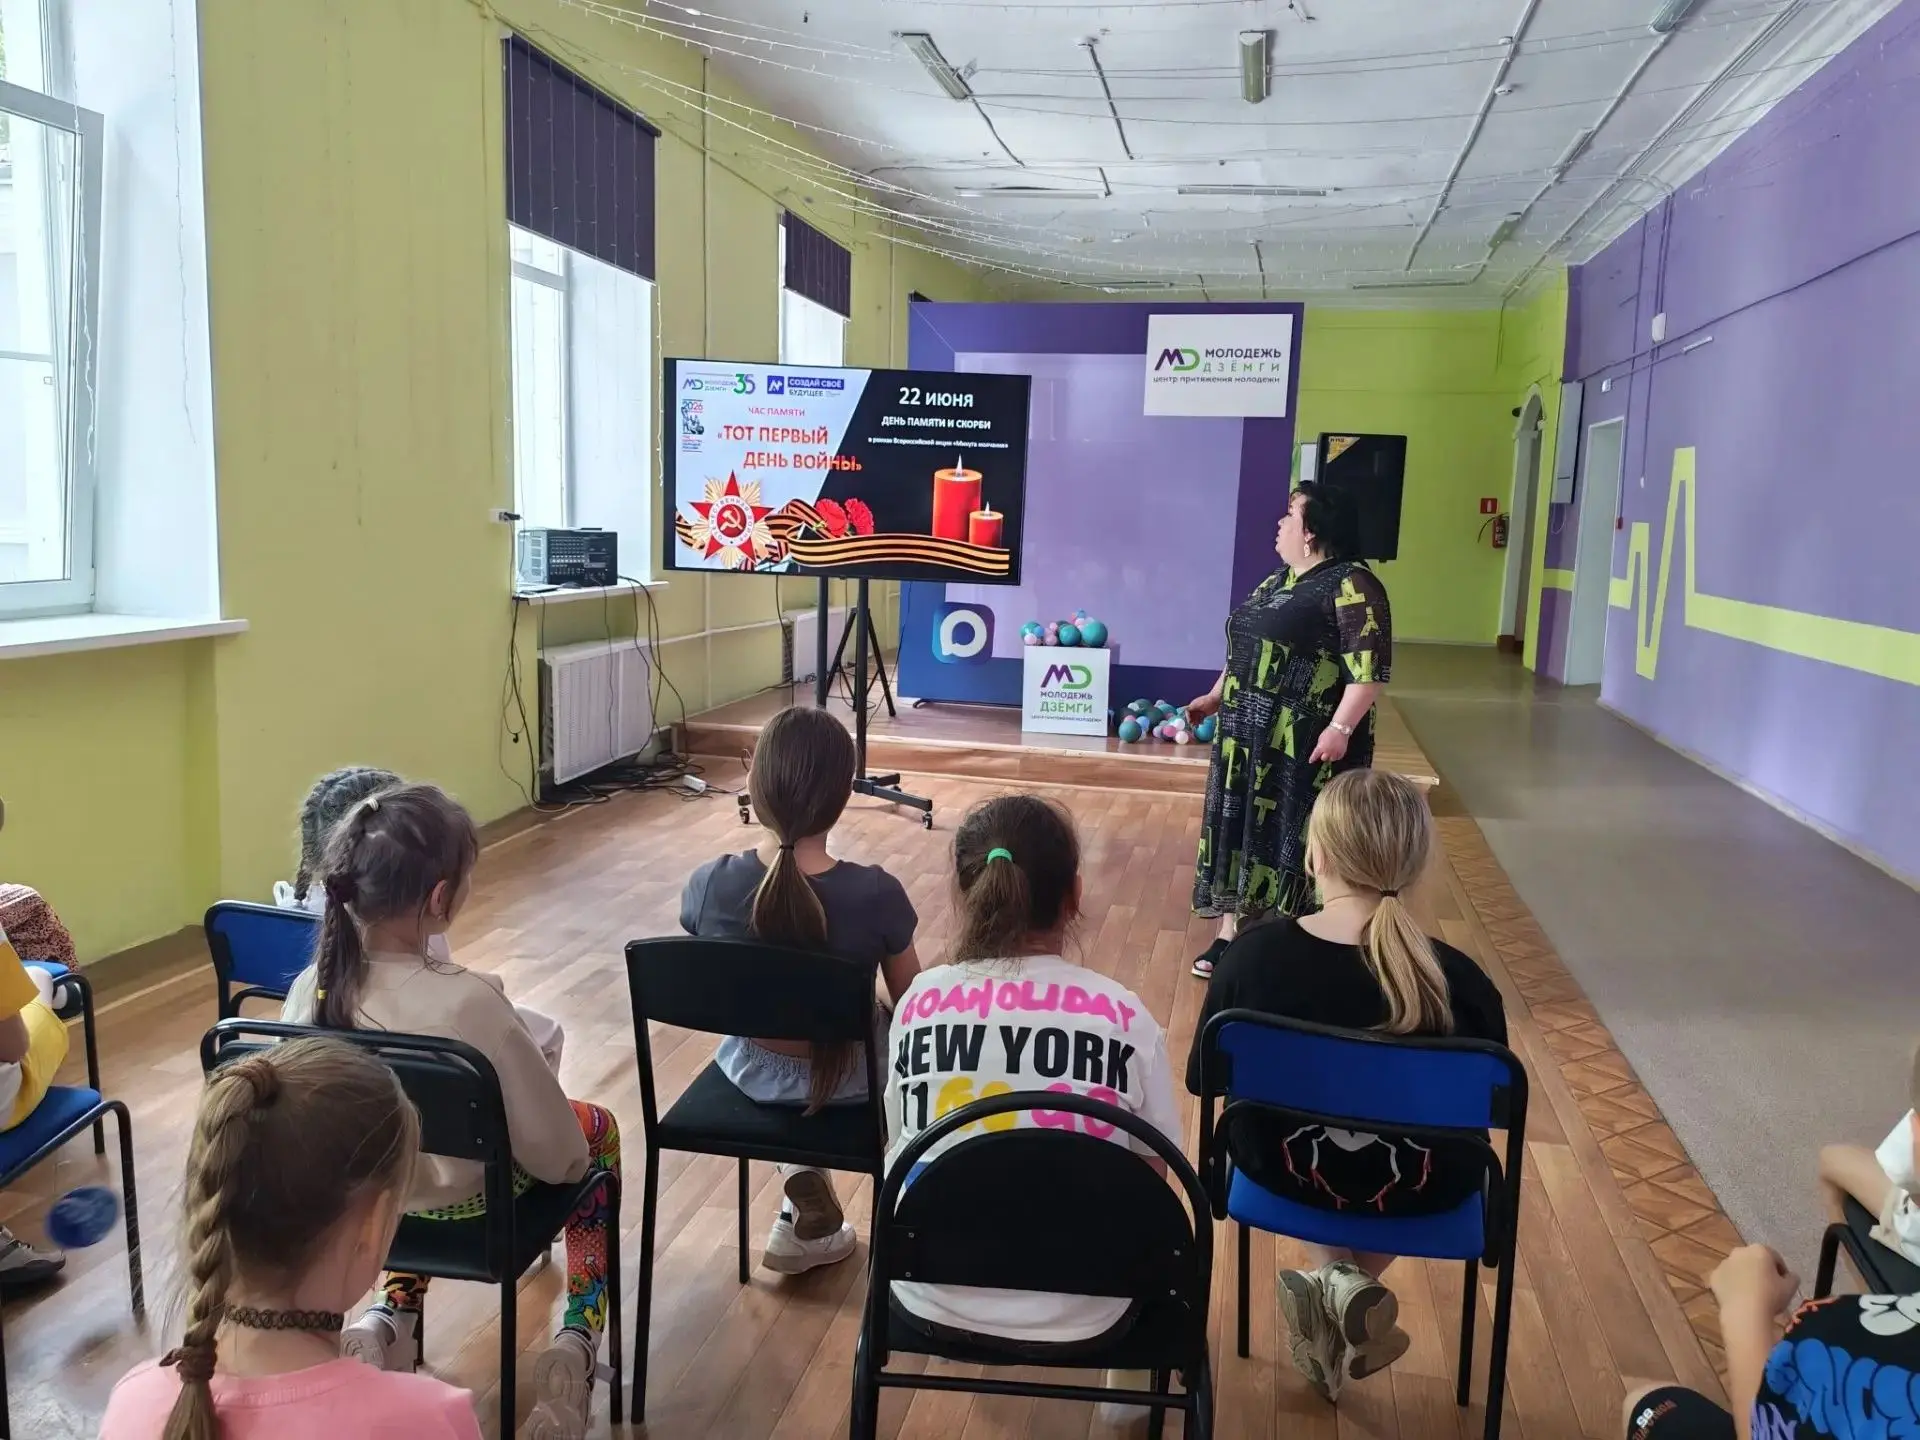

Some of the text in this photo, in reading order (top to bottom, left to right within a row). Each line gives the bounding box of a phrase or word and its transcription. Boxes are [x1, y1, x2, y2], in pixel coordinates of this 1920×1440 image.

[1205, 348, 1282, 359] МОЛОДЕЖЬ
[1203, 360, 1280, 373] ДЗЁМГИ
[733, 374, 756, 395] 35
[789, 378, 819, 387] СОЗДАЙ
[1153, 376, 1177, 384] центр
[1180, 376, 1232, 385] притяжения
[789, 389, 823, 397] БУДУЩЕЕ
[899, 387, 974, 407] 22 ИЮНЯ
[748, 407, 805, 417] ЧАС ПАМЯТИ
[881, 416, 991, 430] ДЕНЬ ПАМЯТИ И СКОРБИ
[759, 426, 828, 445] ПЕРВЫЙ
[743, 451, 863, 472] ДЕНЬ ВОЙНЫ»
[1040, 691, 1093, 700] МОЛОДЕЖЬ
[894, 1024, 1136, 1094] NEW YORK
